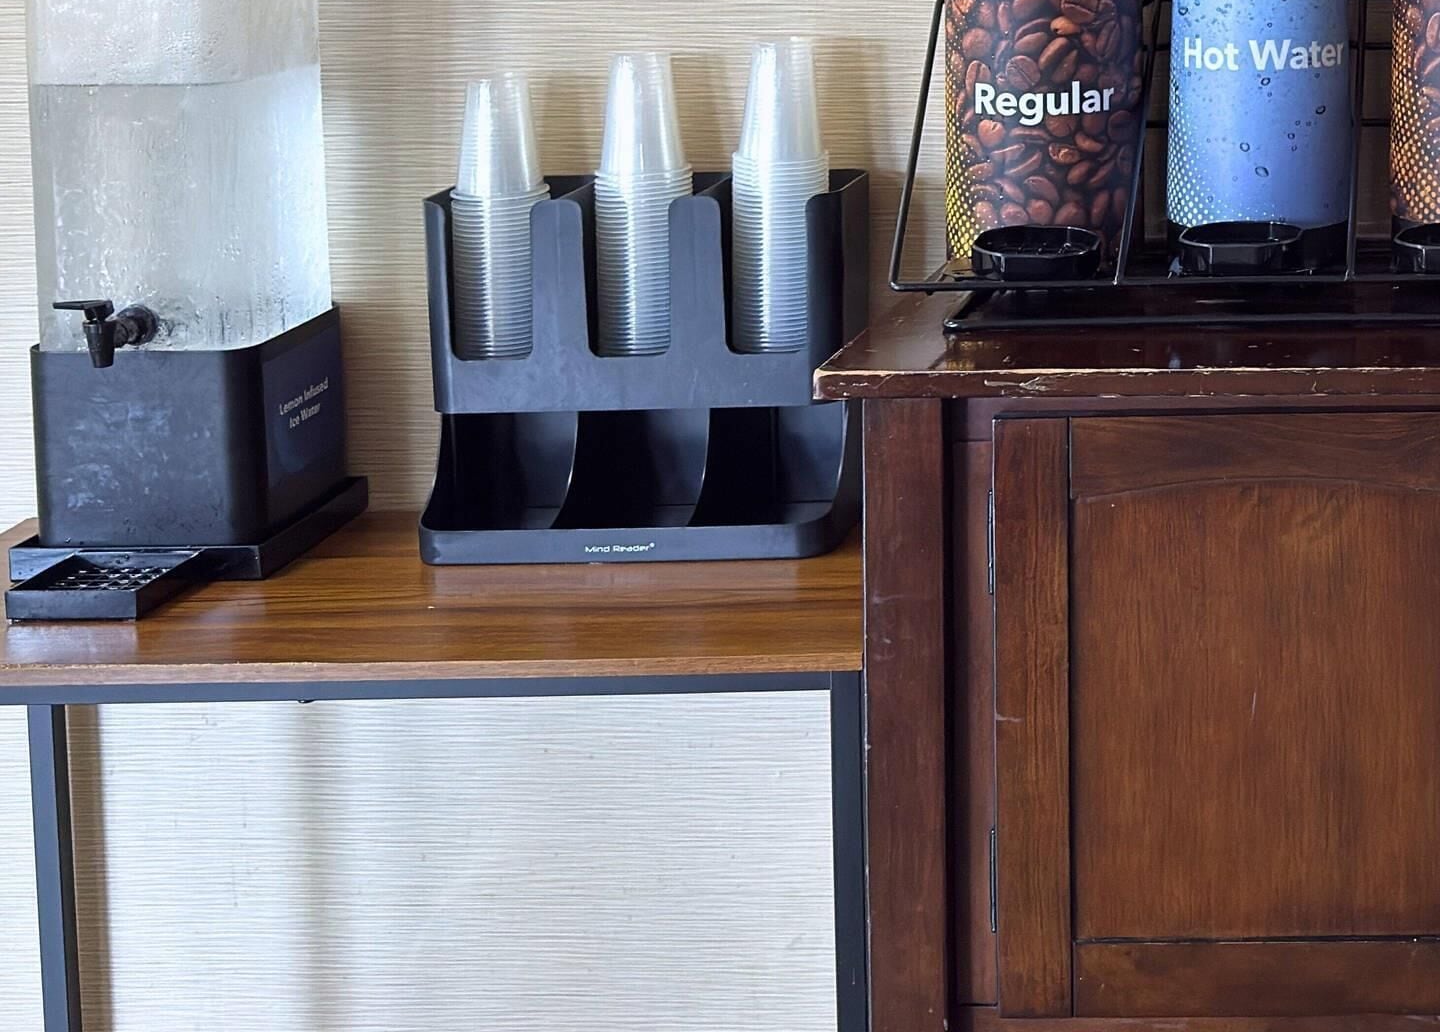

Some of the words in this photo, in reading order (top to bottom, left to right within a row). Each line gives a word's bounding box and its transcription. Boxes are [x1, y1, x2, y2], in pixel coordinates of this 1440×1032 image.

[1182, 36, 1239, 71] Hot
[1249, 37, 1345, 70] Water
[973, 80, 1115, 129] Regular
[279, 394, 303, 416] Lemon
[303, 376, 329, 401] Infused
[289, 415, 300, 429] Ice
[300, 403, 321, 421] Water
[584, 545, 610, 553] Mind
